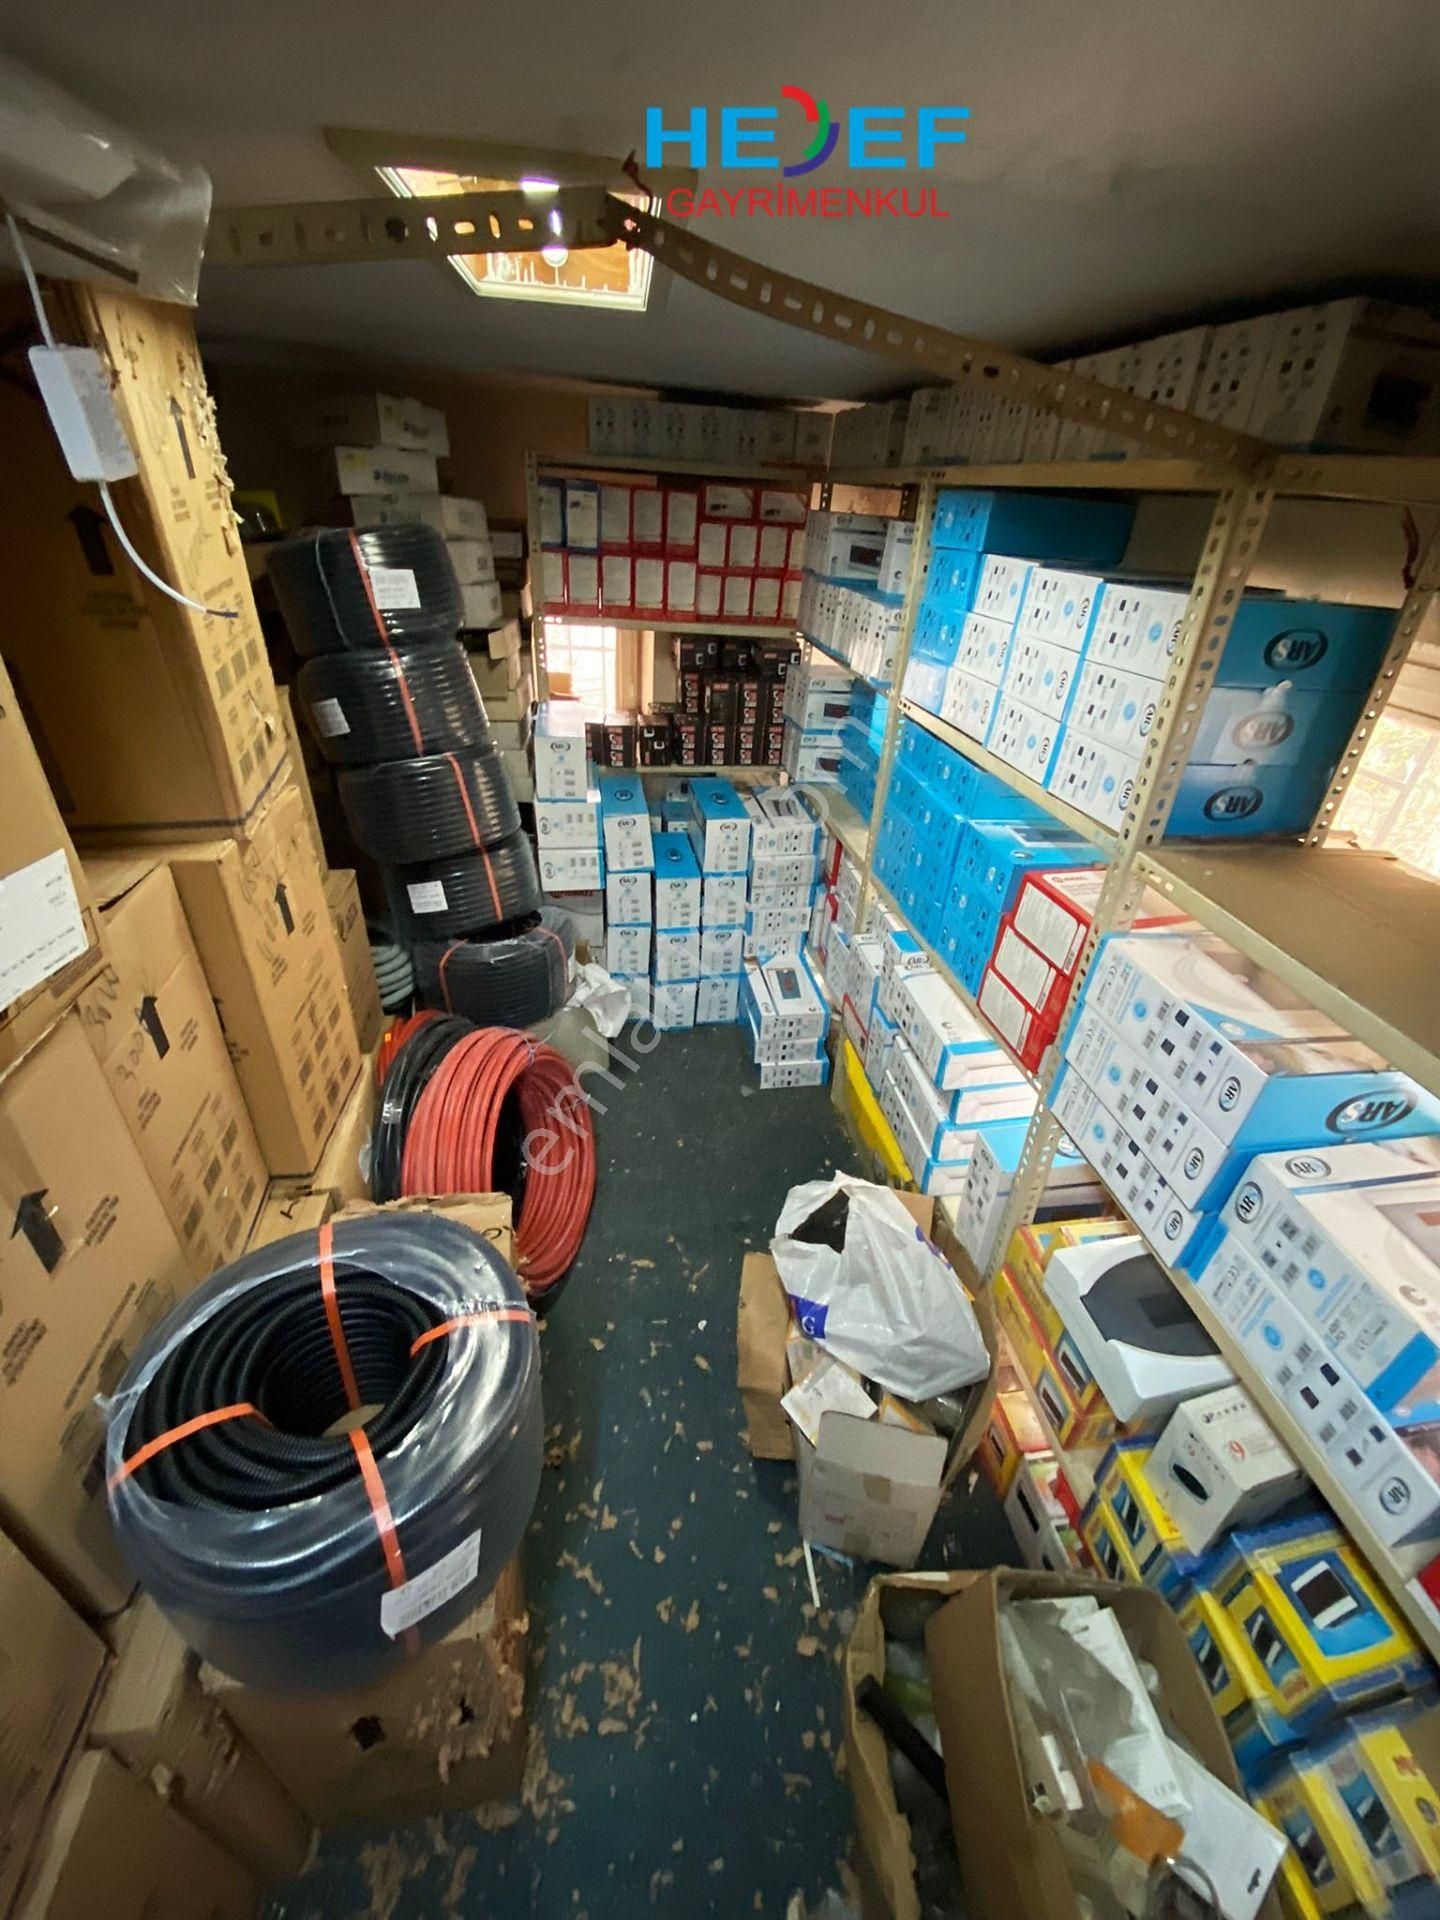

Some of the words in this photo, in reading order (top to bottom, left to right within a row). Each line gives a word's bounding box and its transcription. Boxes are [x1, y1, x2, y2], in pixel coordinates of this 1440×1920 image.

[1273, 640, 1319, 662] ARS
[1246, 722, 1285, 743] ARS
[1216, 795, 1253, 814] ARS
[1339, 1101, 1404, 1125] ARS
